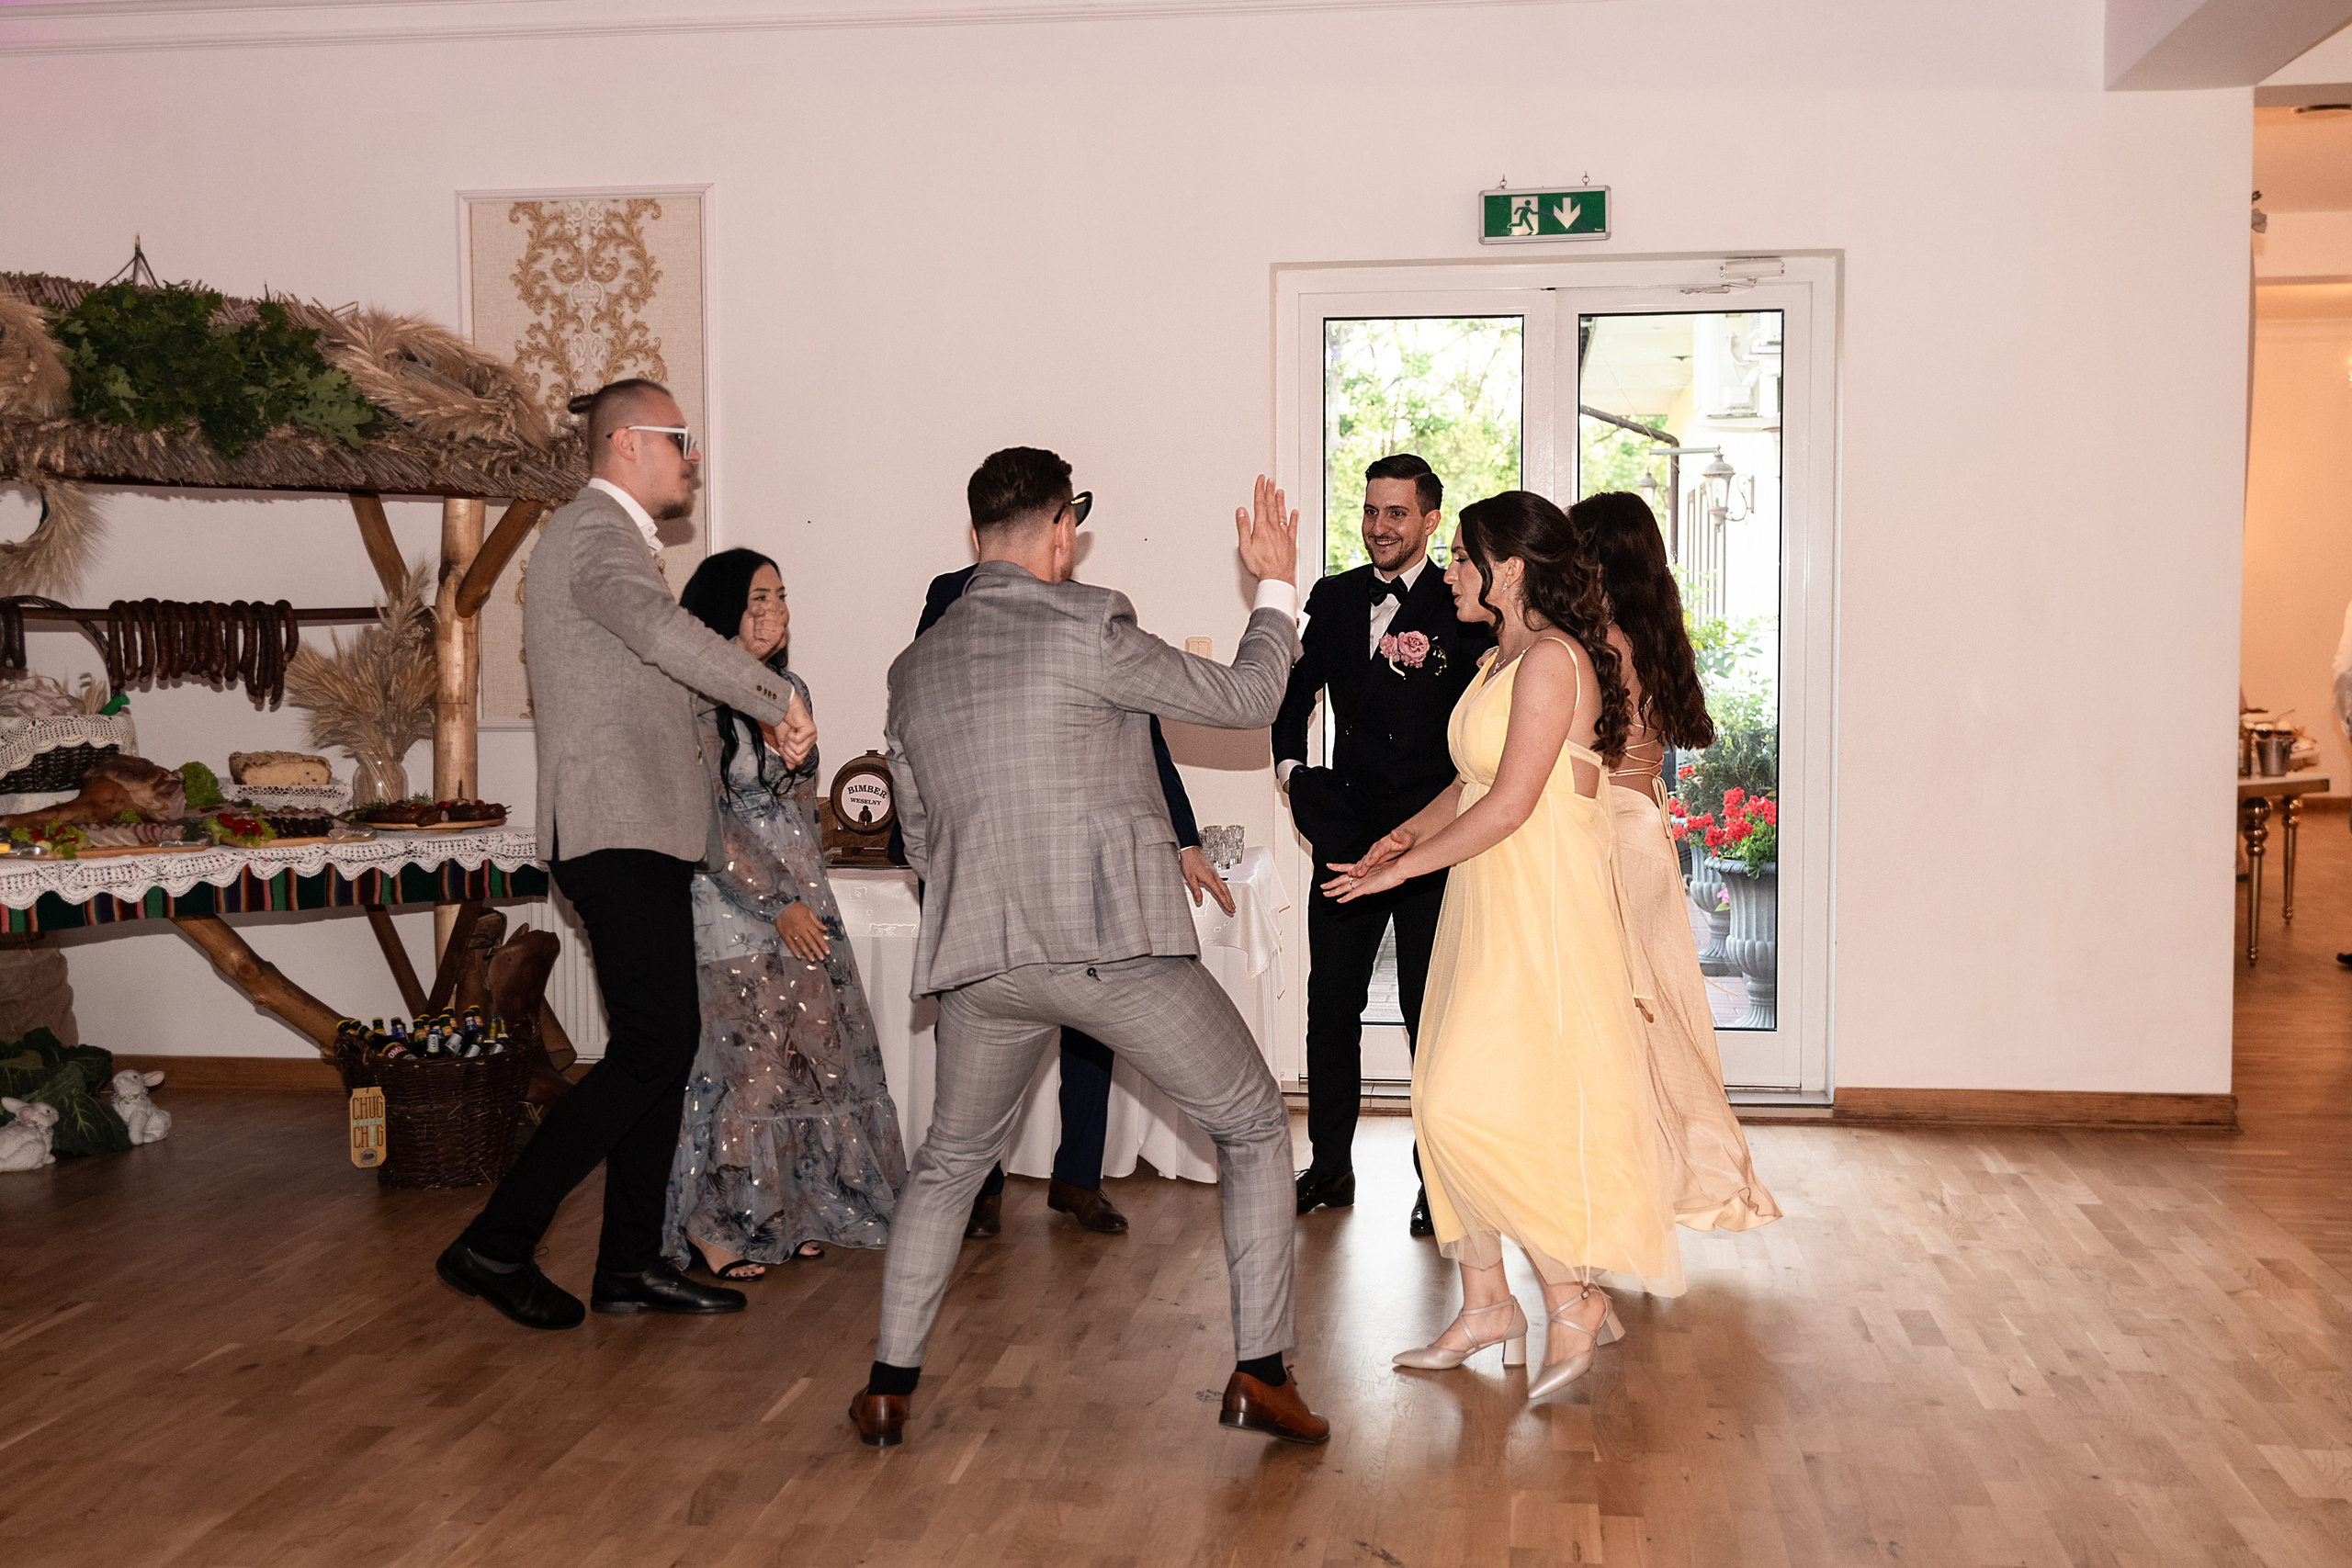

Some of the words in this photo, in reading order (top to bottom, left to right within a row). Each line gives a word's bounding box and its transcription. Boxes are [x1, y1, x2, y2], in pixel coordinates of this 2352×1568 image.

[847, 784, 888, 798] BIMBER
[850, 797, 882, 806] WESELNY
[353, 1095, 383, 1120] CHUG
